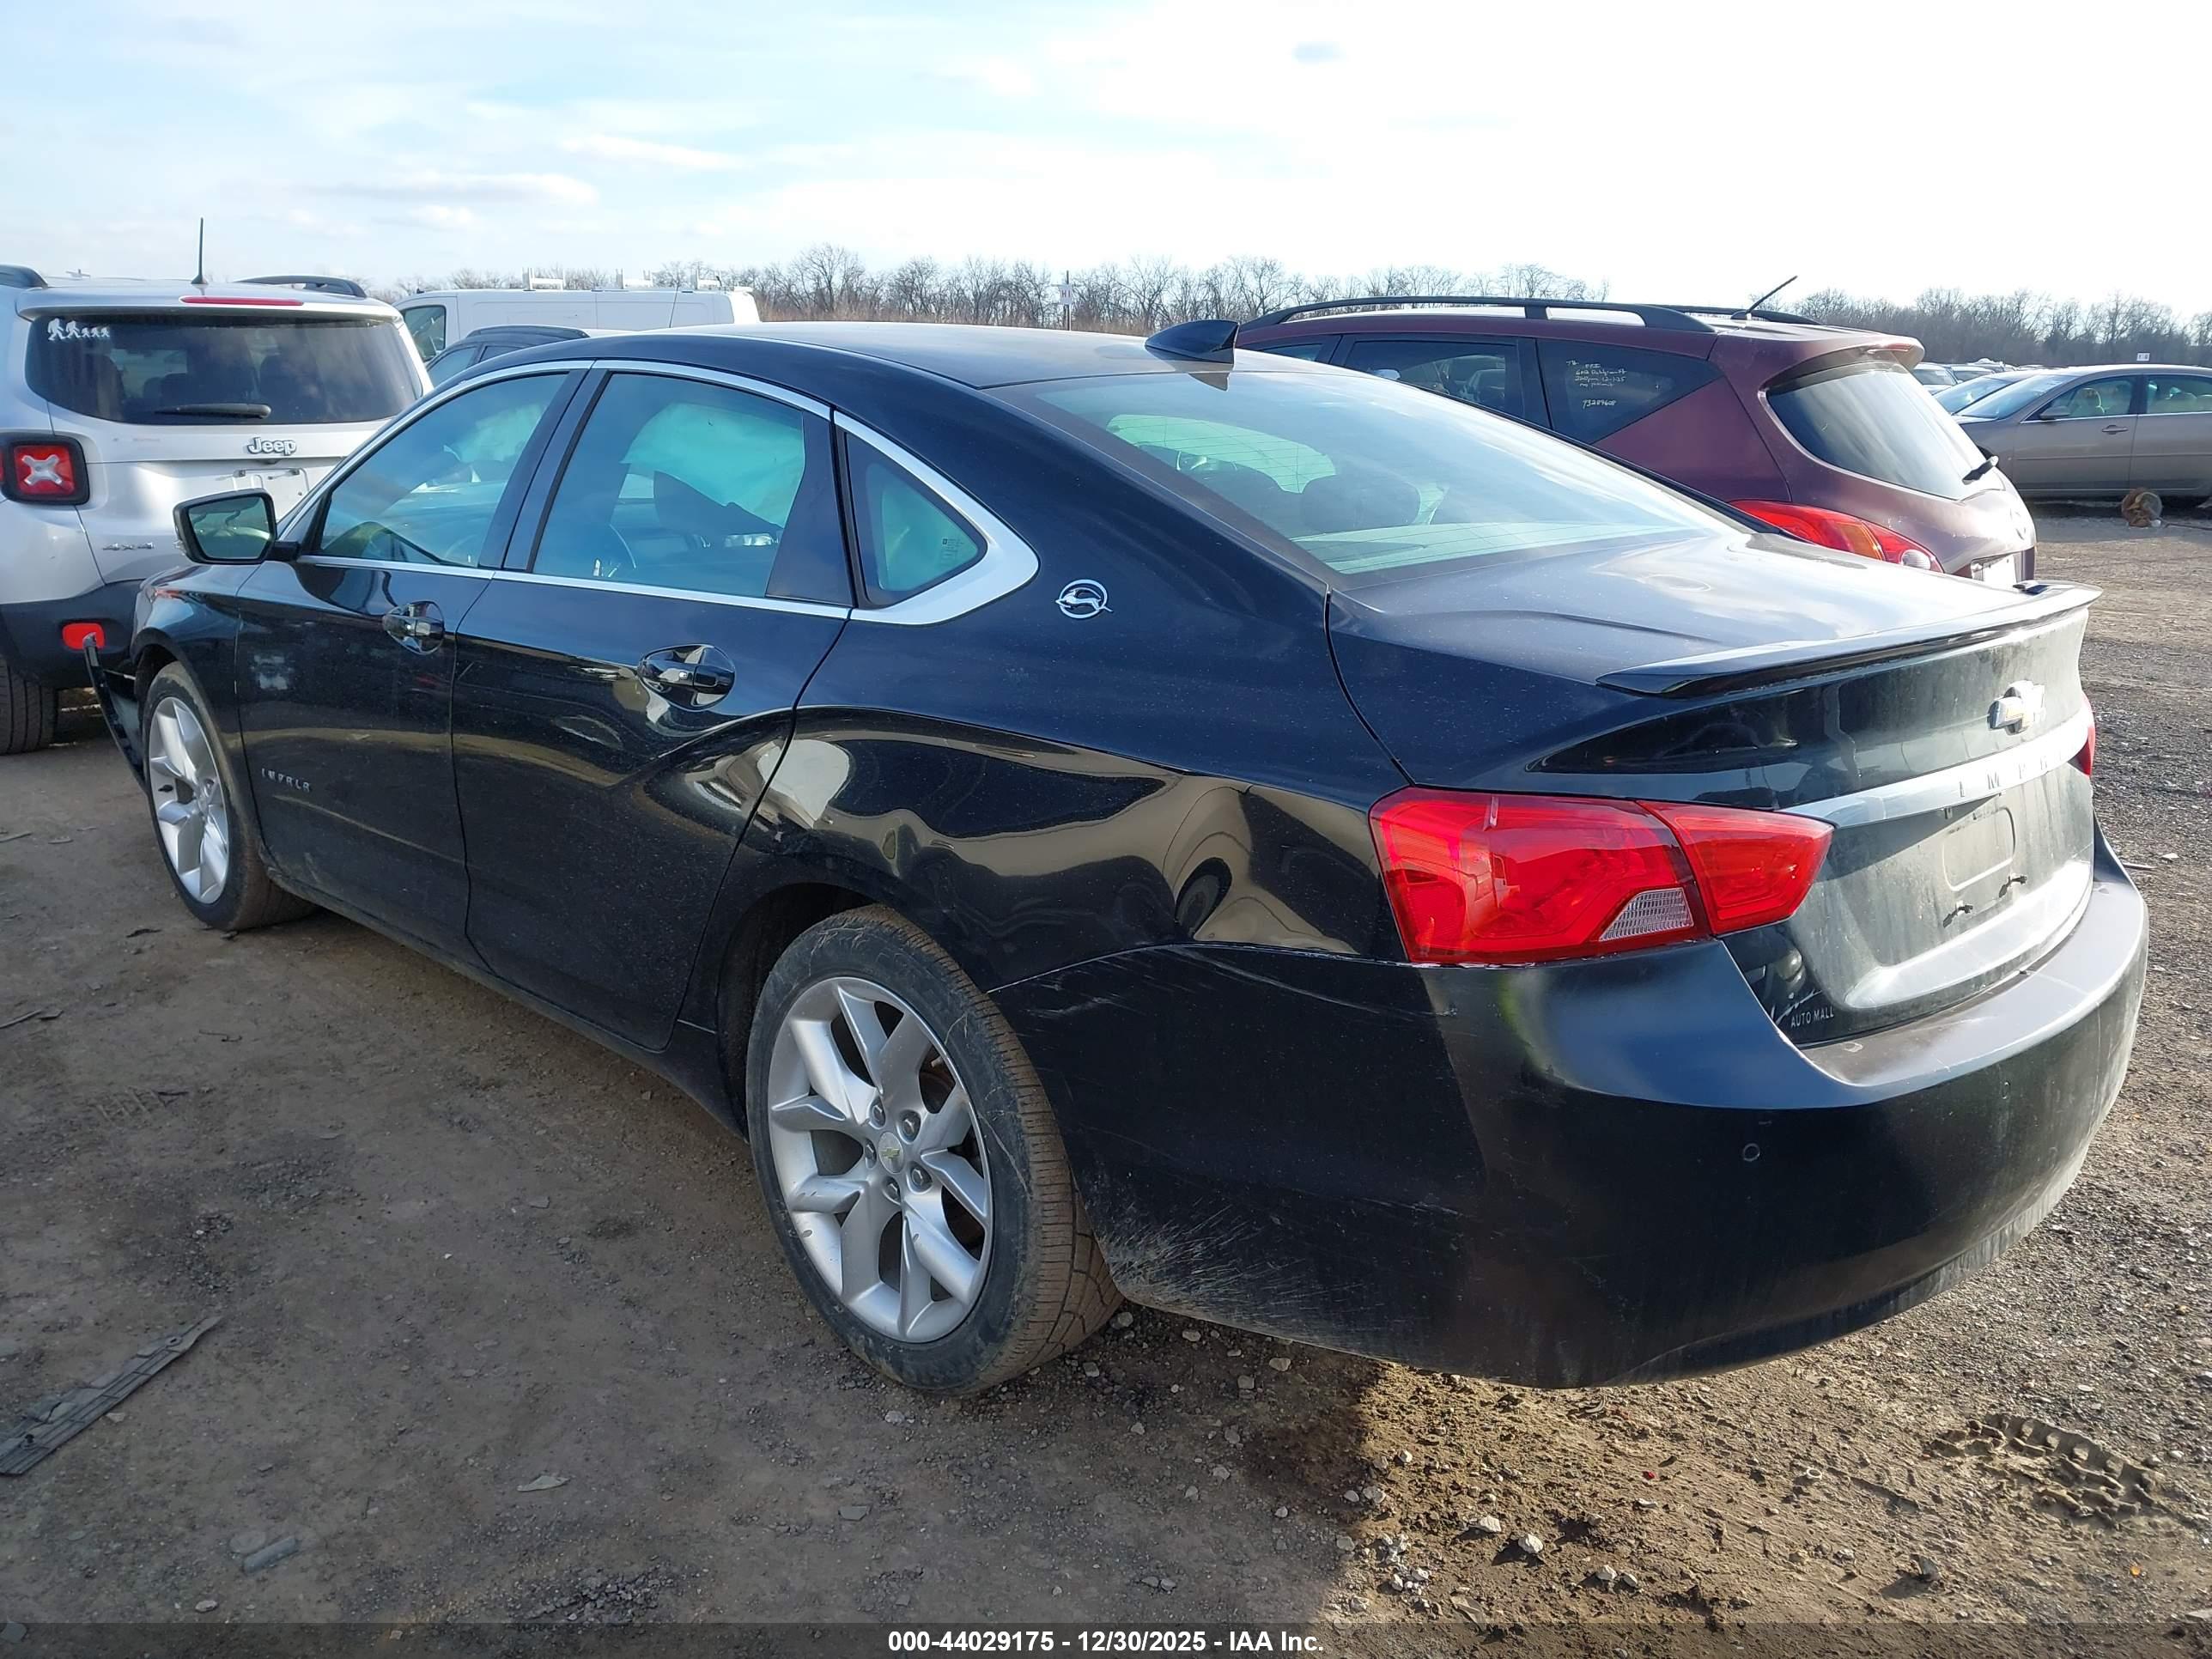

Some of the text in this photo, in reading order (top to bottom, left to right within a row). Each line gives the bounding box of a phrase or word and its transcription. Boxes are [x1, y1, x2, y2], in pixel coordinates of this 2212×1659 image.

[247, 436, 296, 456] Jeep
[1791, 1011, 1812, 1028] AUTO
[1813, 1006, 1835, 1022] MALL
